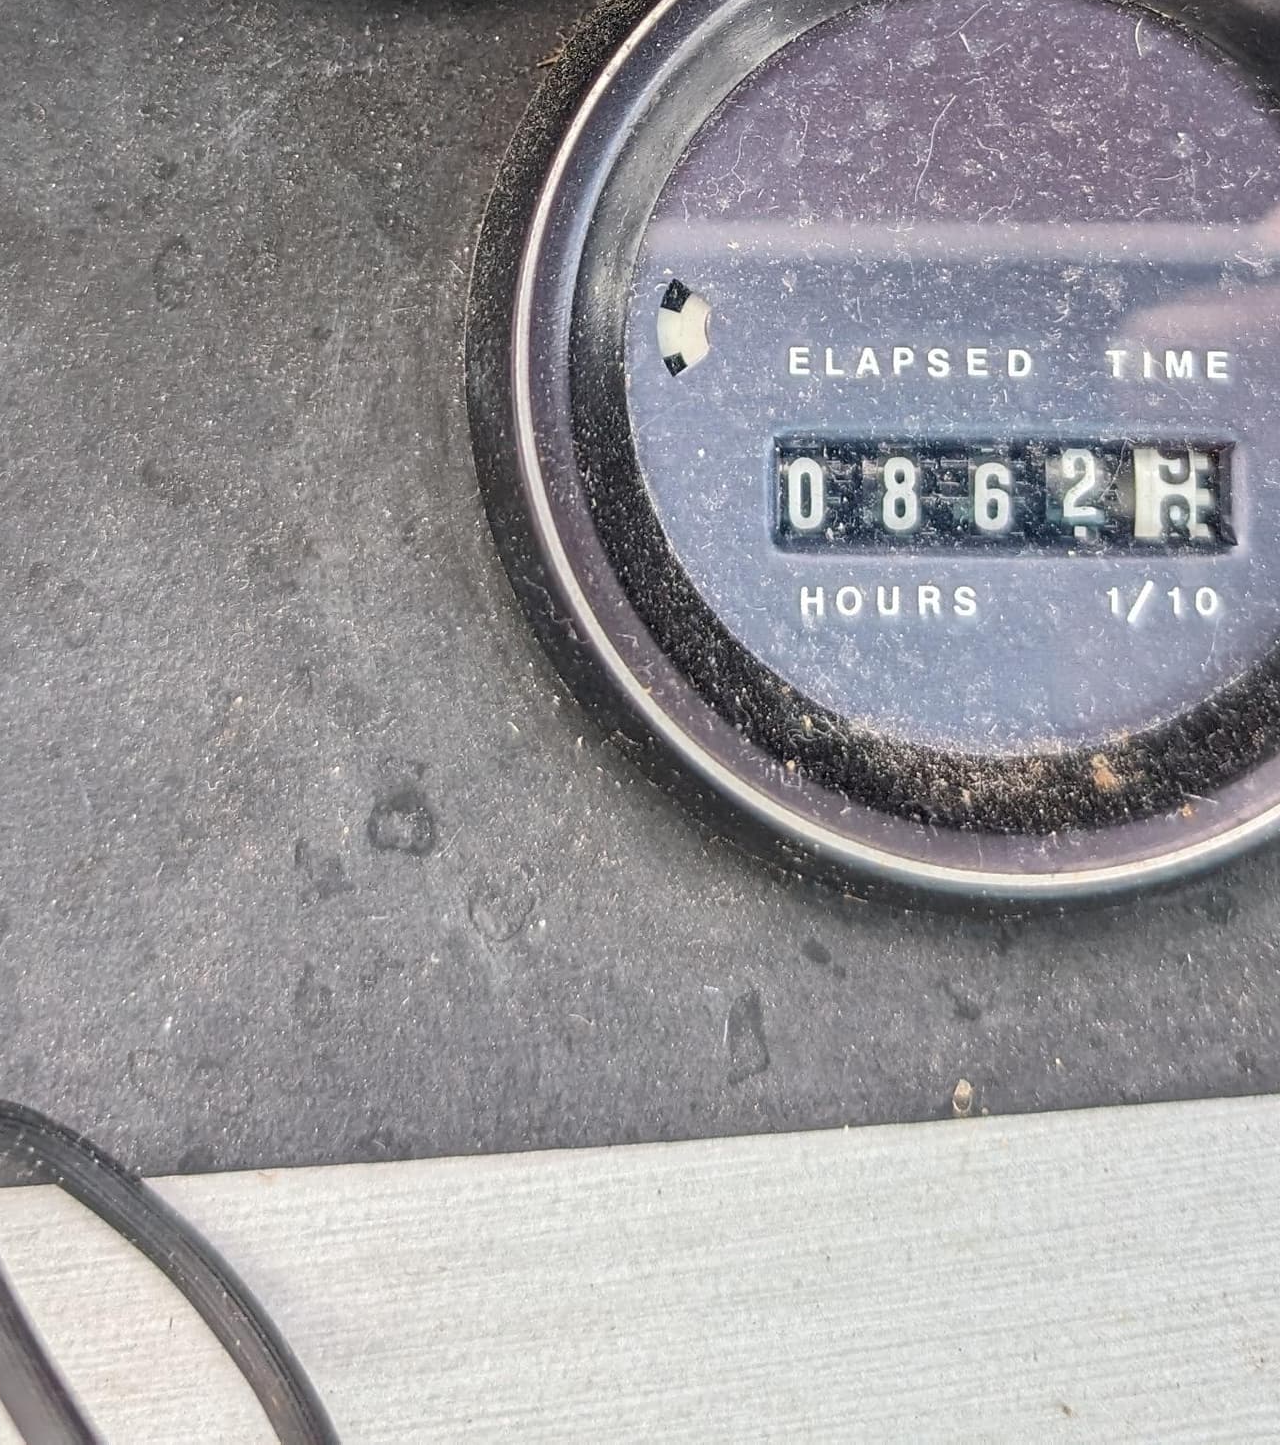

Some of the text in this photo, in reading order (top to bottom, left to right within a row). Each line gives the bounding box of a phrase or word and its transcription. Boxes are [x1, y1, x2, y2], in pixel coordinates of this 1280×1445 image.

[788, 346, 1230, 380] ELAPSED TIME
[799, 580, 1220, 624] HOURS 1/10
